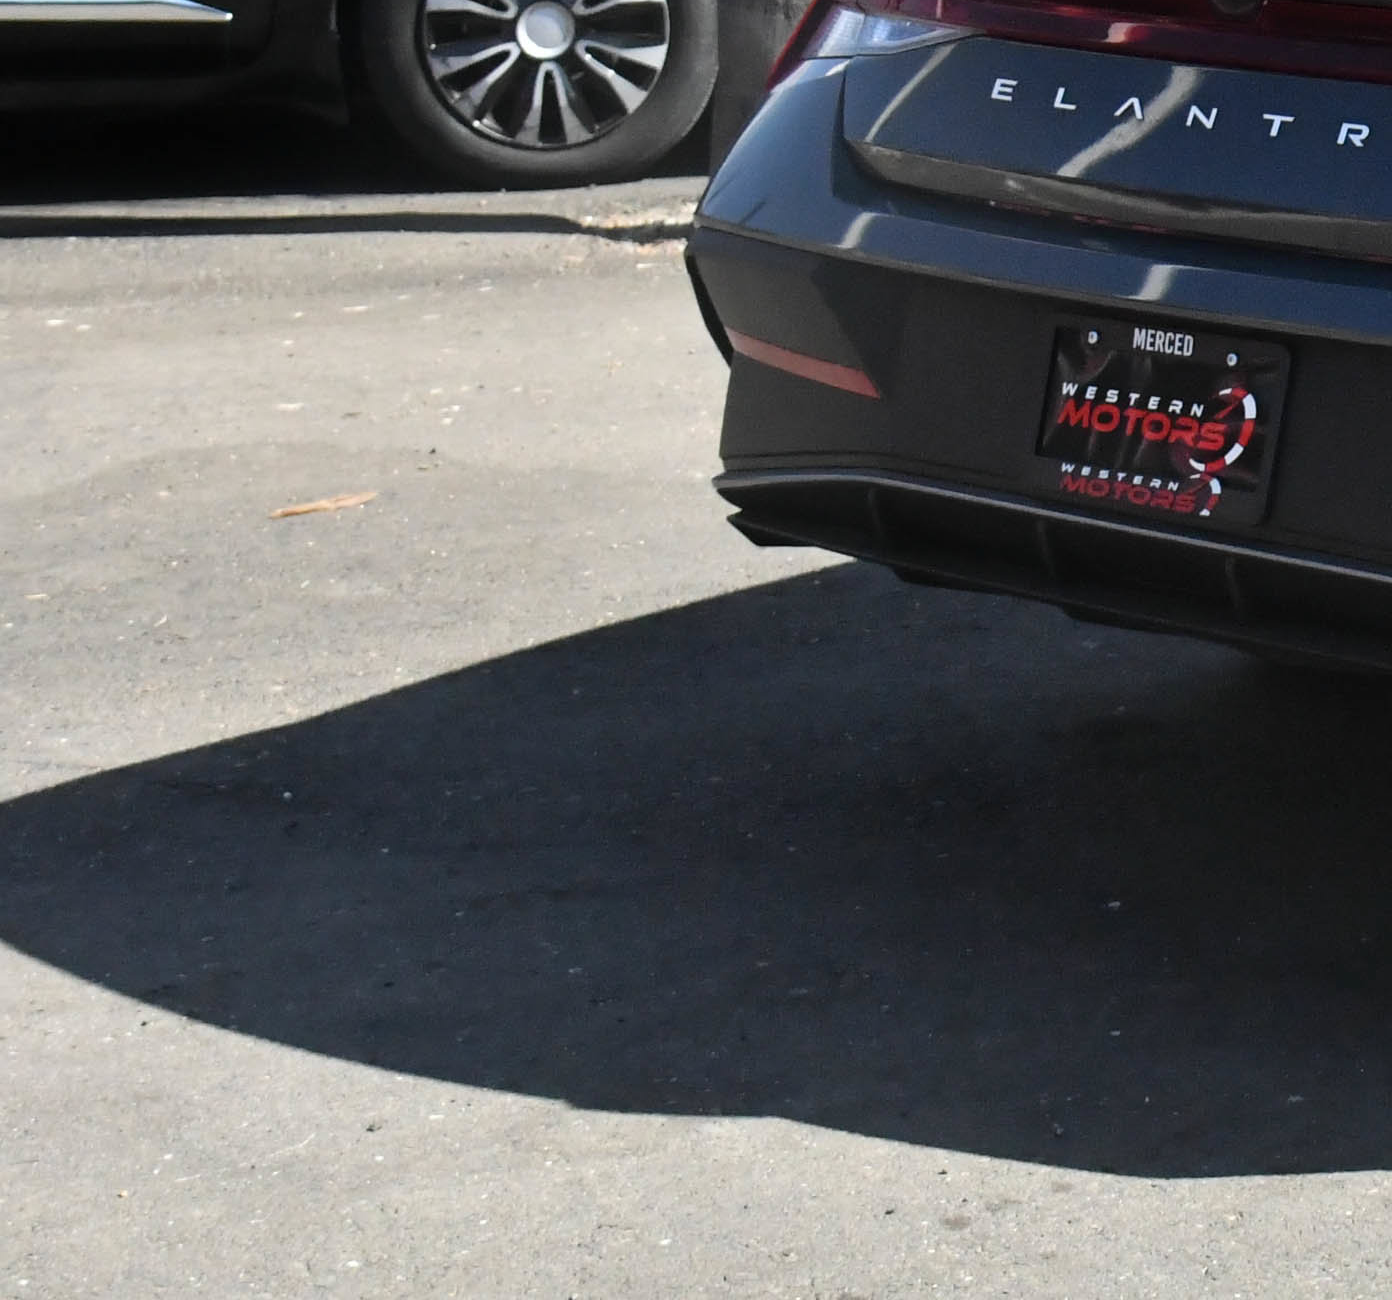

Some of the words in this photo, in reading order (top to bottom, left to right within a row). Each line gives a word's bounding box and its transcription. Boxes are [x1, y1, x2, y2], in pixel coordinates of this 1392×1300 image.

[1132, 327, 1195, 358] MERCED
[1060, 381, 1205, 418] WESTERN
[1057, 397, 1228, 452] MOTORS
[1059, 474, 1197, 514] MOTORS
[1060, 462, 1181, 491] WESTERN
